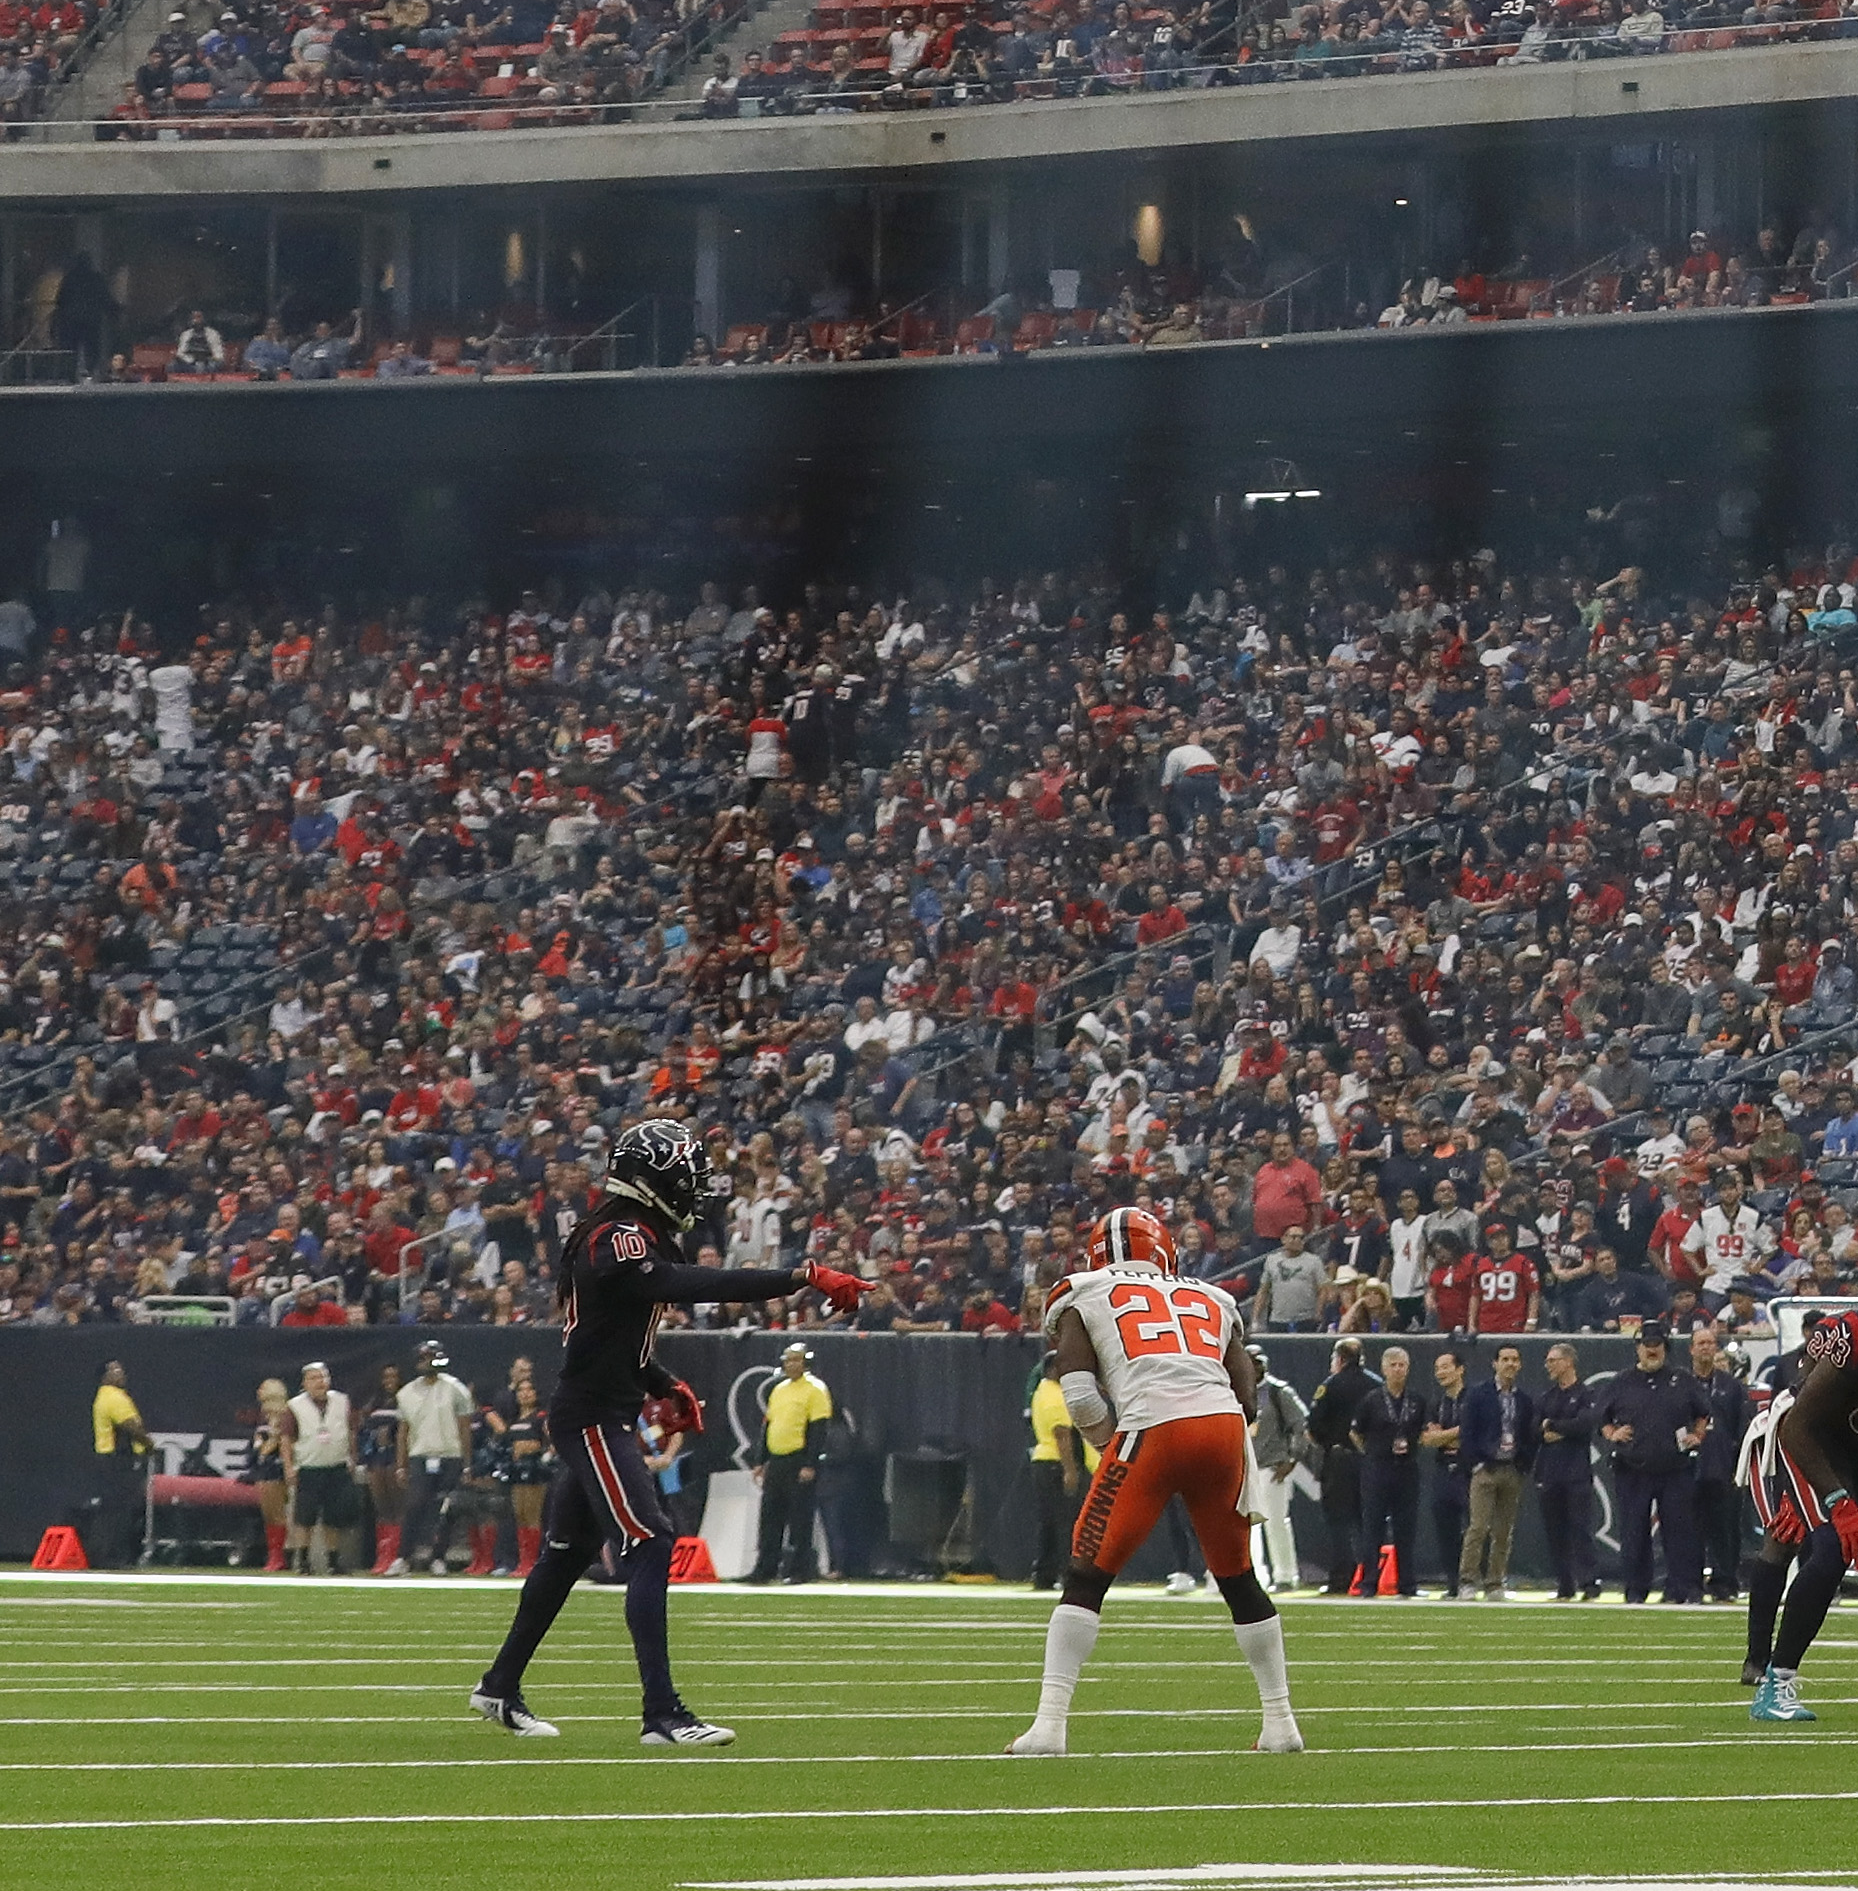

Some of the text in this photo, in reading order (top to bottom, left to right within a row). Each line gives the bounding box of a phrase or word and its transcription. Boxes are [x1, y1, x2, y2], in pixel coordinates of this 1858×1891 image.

[613, 1232, 646, 1263] 10
[1345, 1238, 1361, 1267] 7
[1403, 1241, 1411, 1260] 4
[1715, 1232, 1744, 1258] 99
[1480, 1271, 1518, 1302] 99
[1109, 1283, 1222, 1360] 22
[1074, 1461, 1127, 1560] BROWNS
